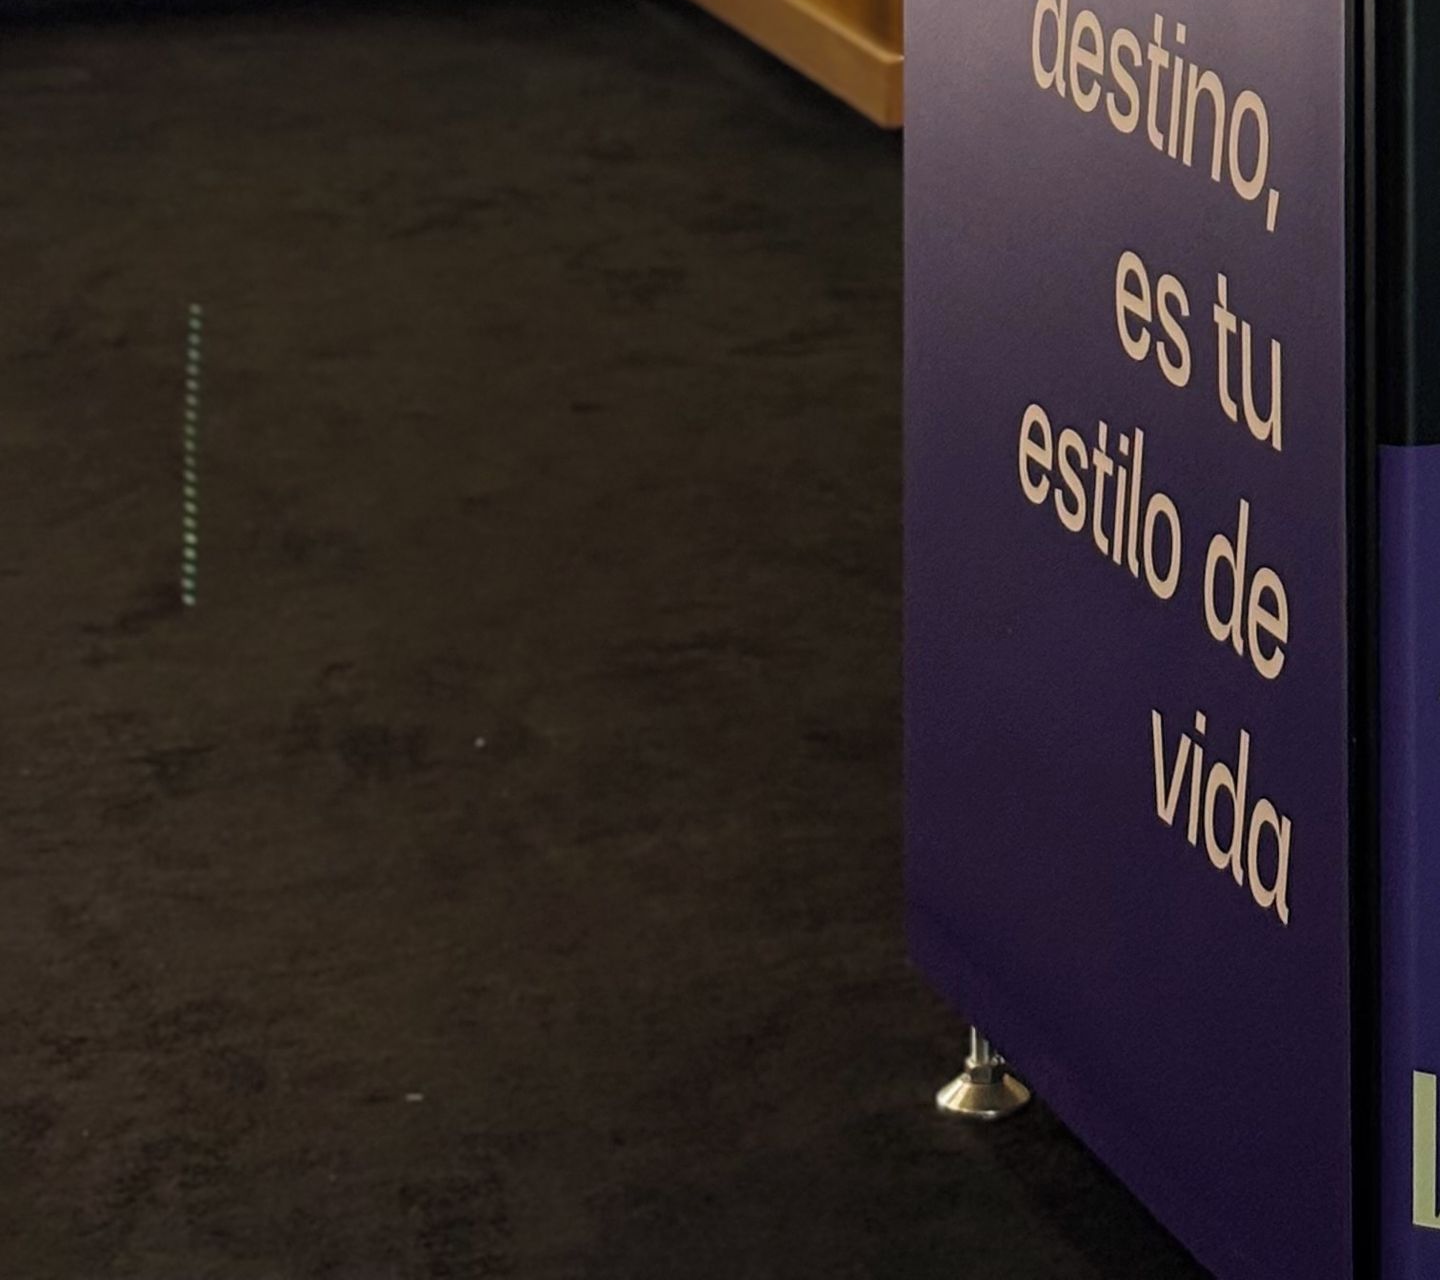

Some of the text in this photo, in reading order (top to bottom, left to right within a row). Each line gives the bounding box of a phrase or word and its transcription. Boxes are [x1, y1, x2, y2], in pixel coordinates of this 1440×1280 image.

[1113, 249, 1283, 453] es tu
[1017, 402, 1289, 681] estilo de
[1151, 709, 1292, 924] vida
